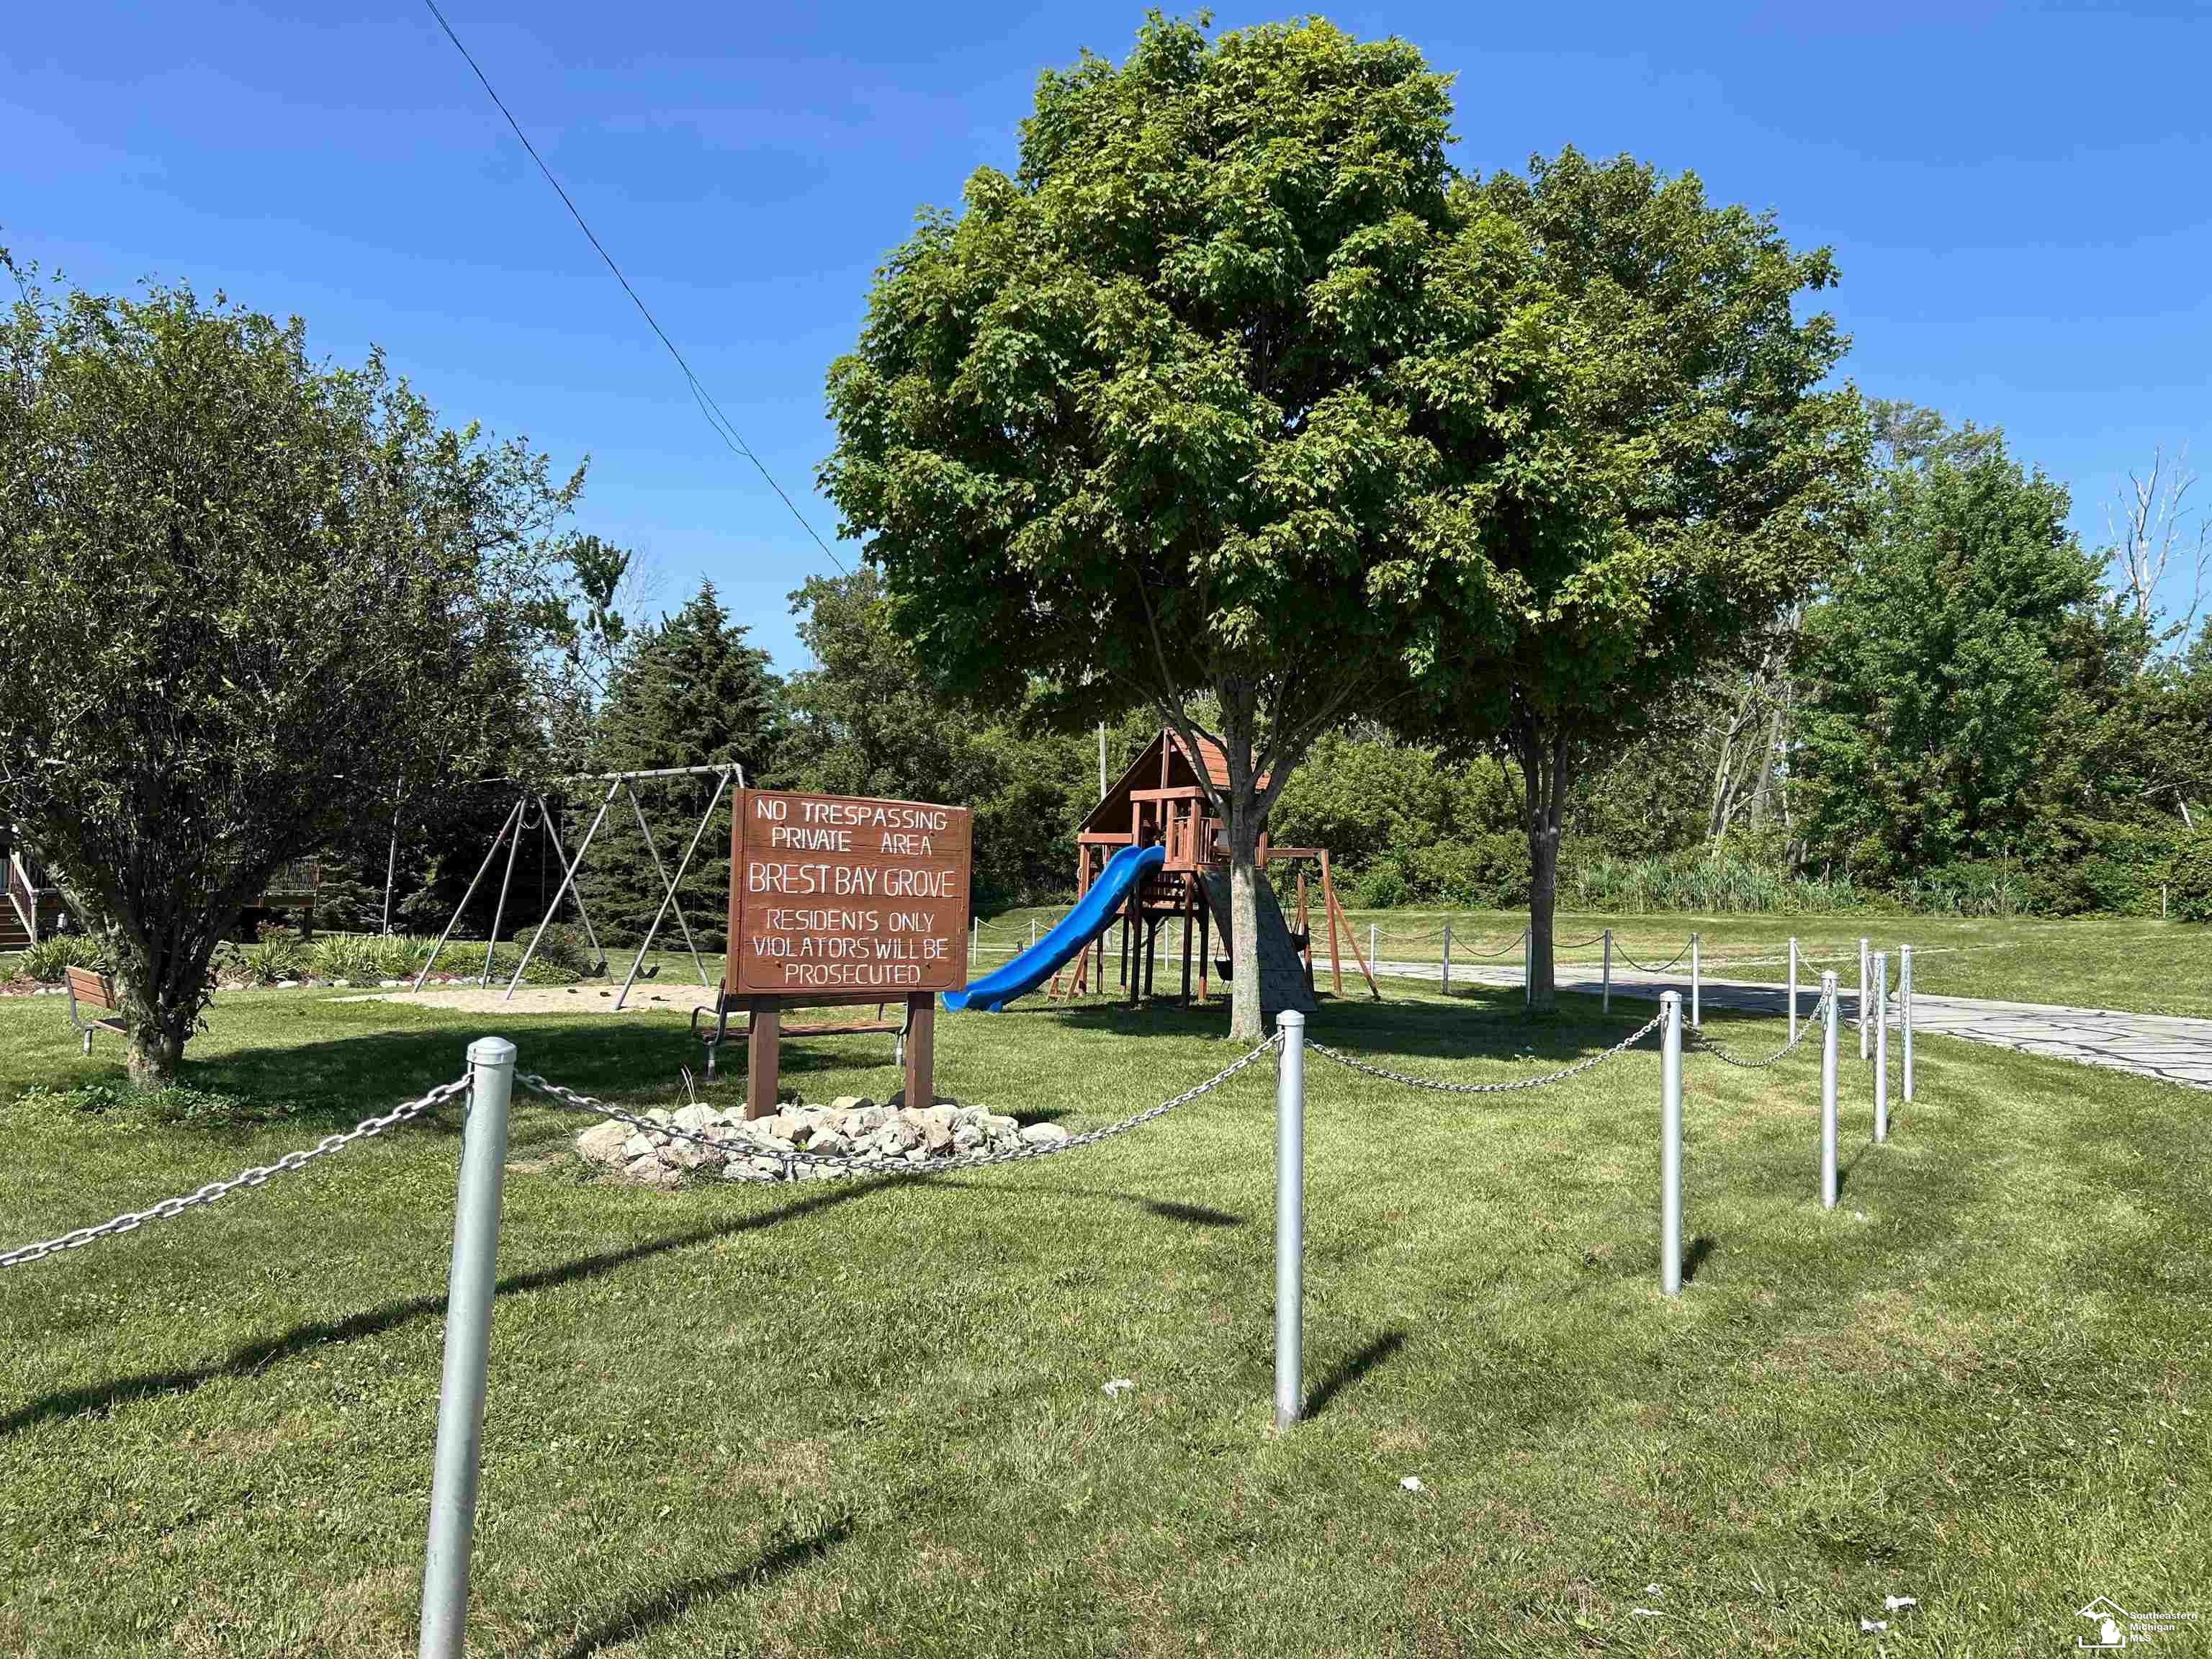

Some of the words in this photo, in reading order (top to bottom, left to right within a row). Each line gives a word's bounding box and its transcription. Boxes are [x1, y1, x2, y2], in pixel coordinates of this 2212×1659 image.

[757, 799, 786, 821] NO
[801, 802, 947, 830] TRESPASSING
[772, 827, 852, 852] PRIVATE
[881, 832, 932, 855] AREA
[749, 863, 830, 894] BREST
[835, 866, 876, 896] BAY
[884, 868, 956, 897] GROVE
[766, 909, 878, 931] RESIDENTS
[889, 912, 935, 932] ONLY
[753, 937, 869, 958] VIOLATORS
[876, 938, 919, 959] WILL
[924, 938, 949, 960] BE
[785, 964, 920, 984] PROSECUTED
